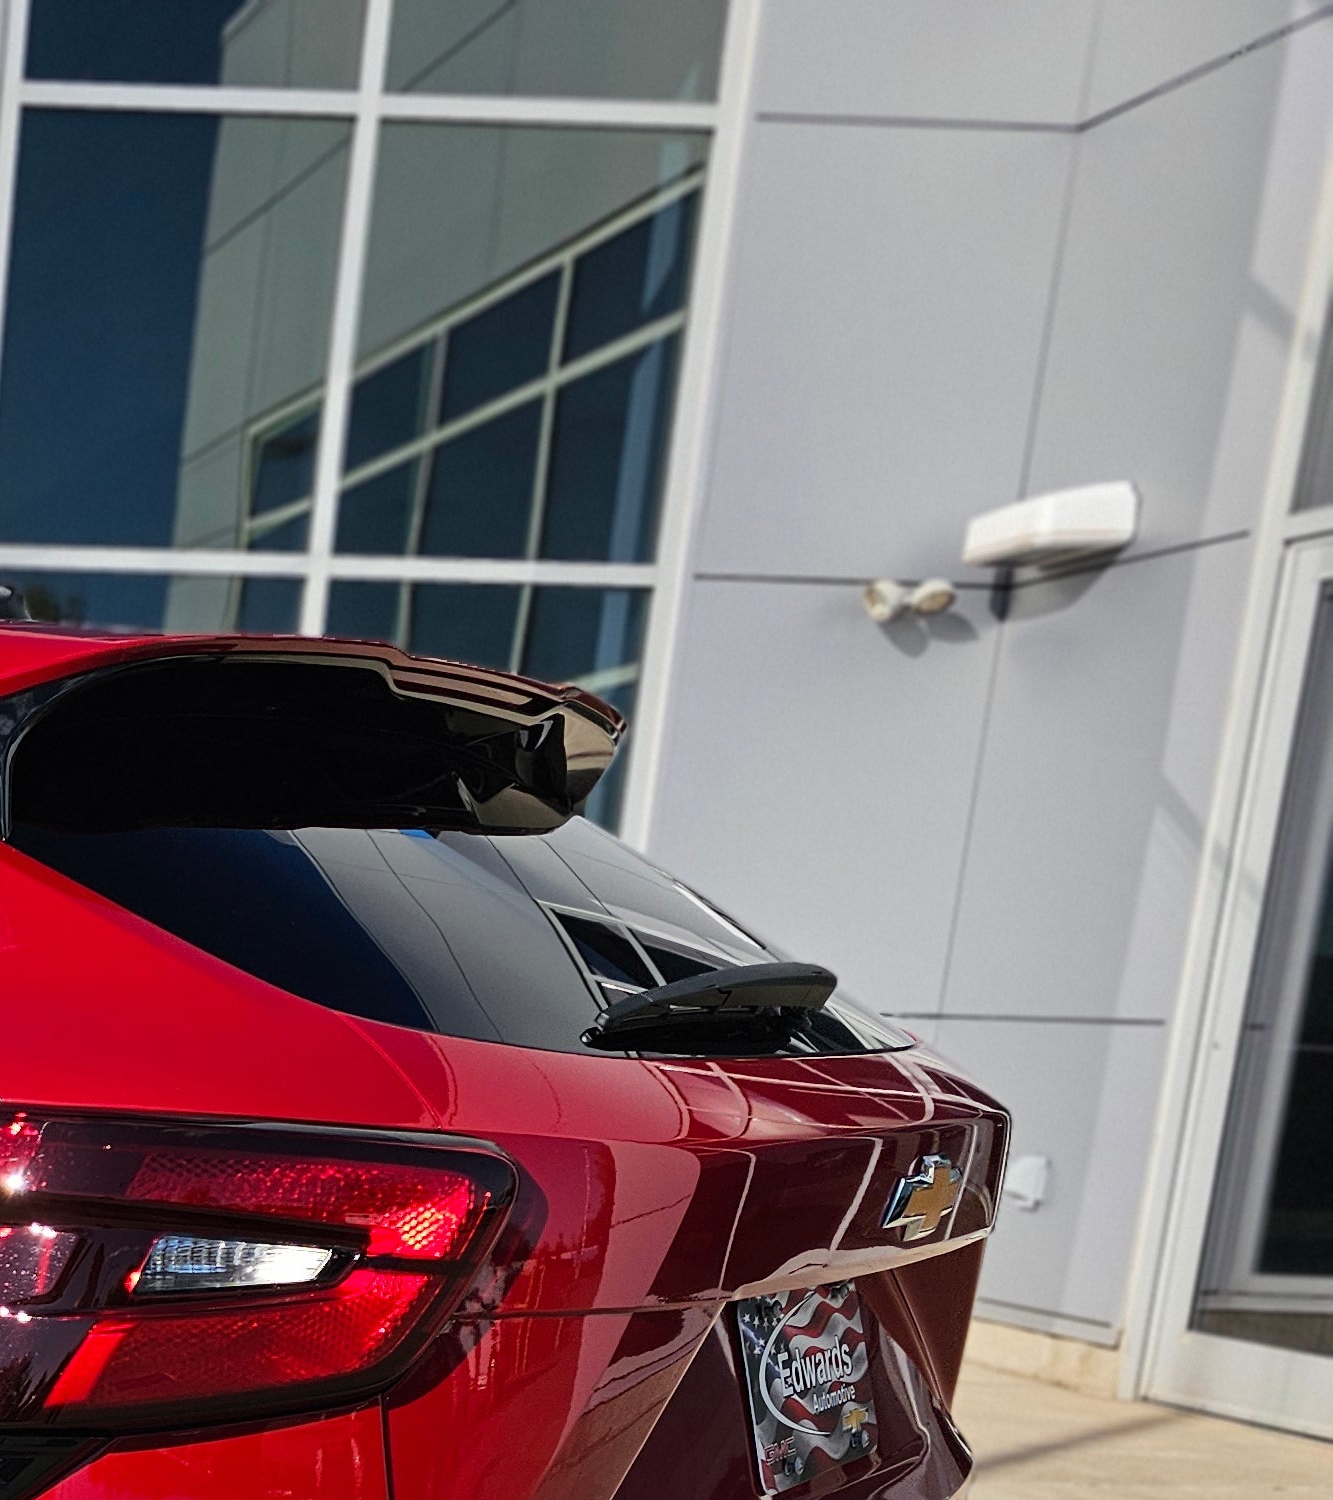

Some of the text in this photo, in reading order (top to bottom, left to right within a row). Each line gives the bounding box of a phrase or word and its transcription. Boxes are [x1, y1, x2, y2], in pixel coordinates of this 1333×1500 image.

[777, 1335, 852, 1399] Edwards
[812, 1383, 856, 1415] Automotive
[764, 1435, 796, 1466] GMC
